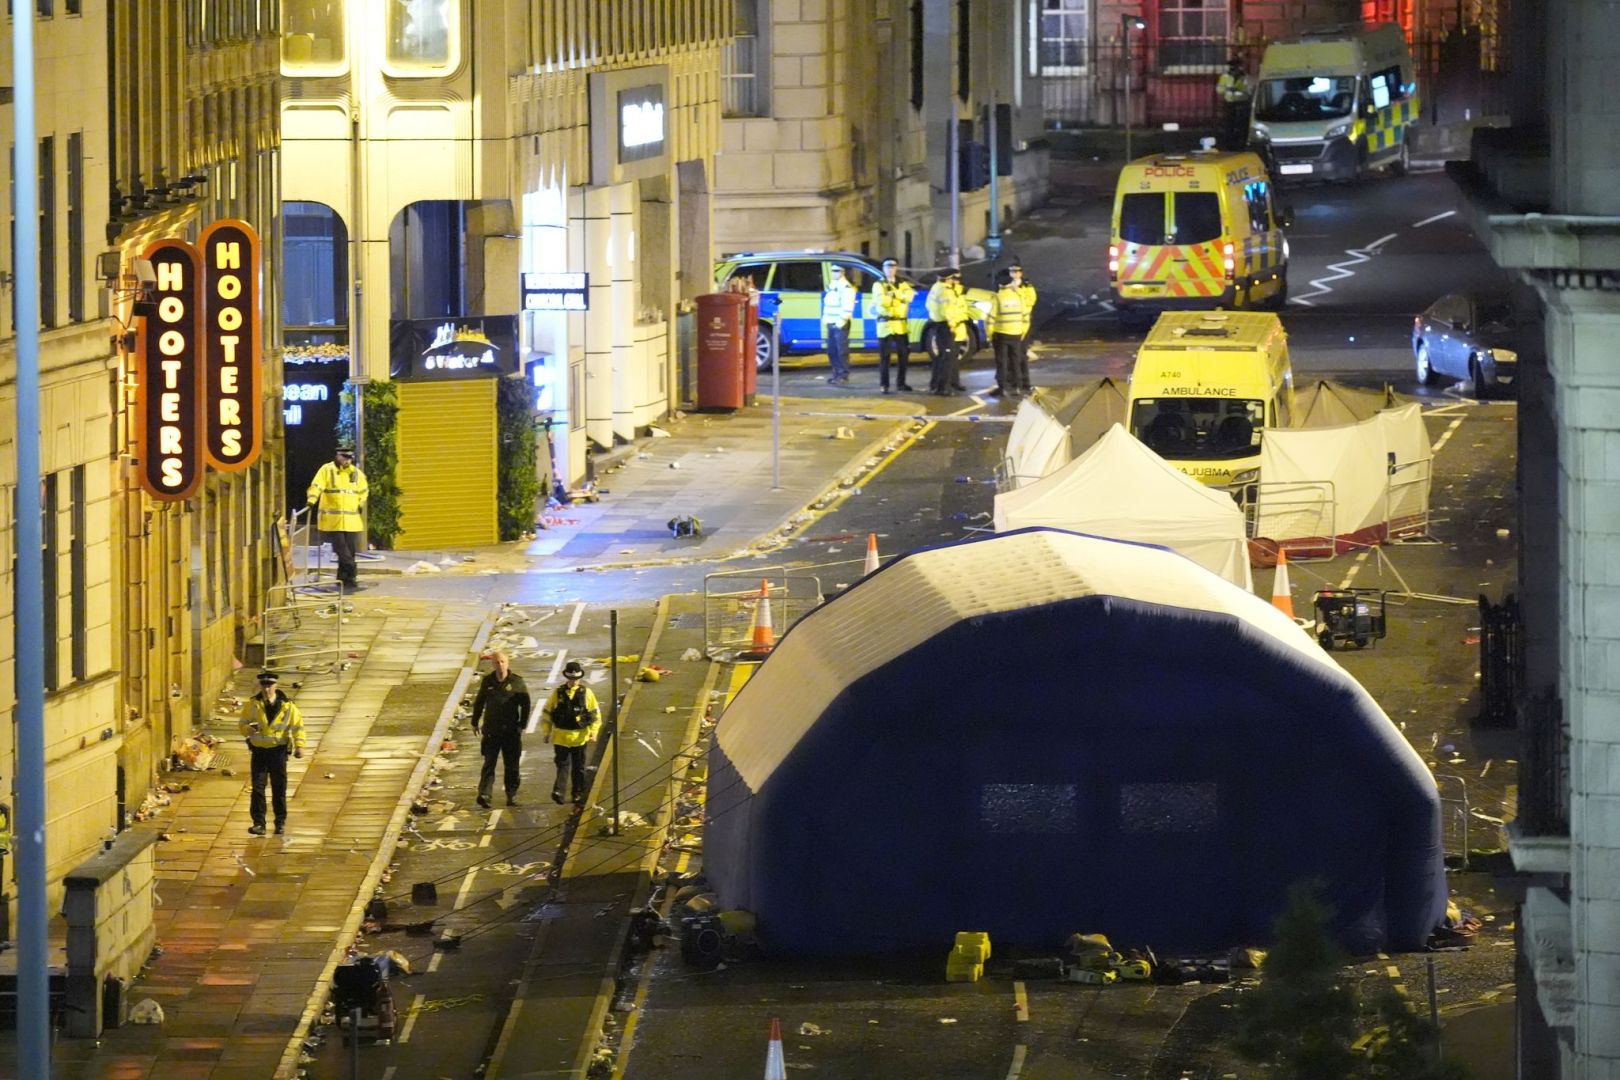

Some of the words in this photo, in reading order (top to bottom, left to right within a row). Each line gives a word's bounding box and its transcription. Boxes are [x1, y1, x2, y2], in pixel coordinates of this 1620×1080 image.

[1144, 166, 1194, 177] POLICE
[157, 262, 185, 487] HOOTERS
[216, 242, 242, 457] HOOTERS
[1162, 387, 1237, 397] AMBULANCE
